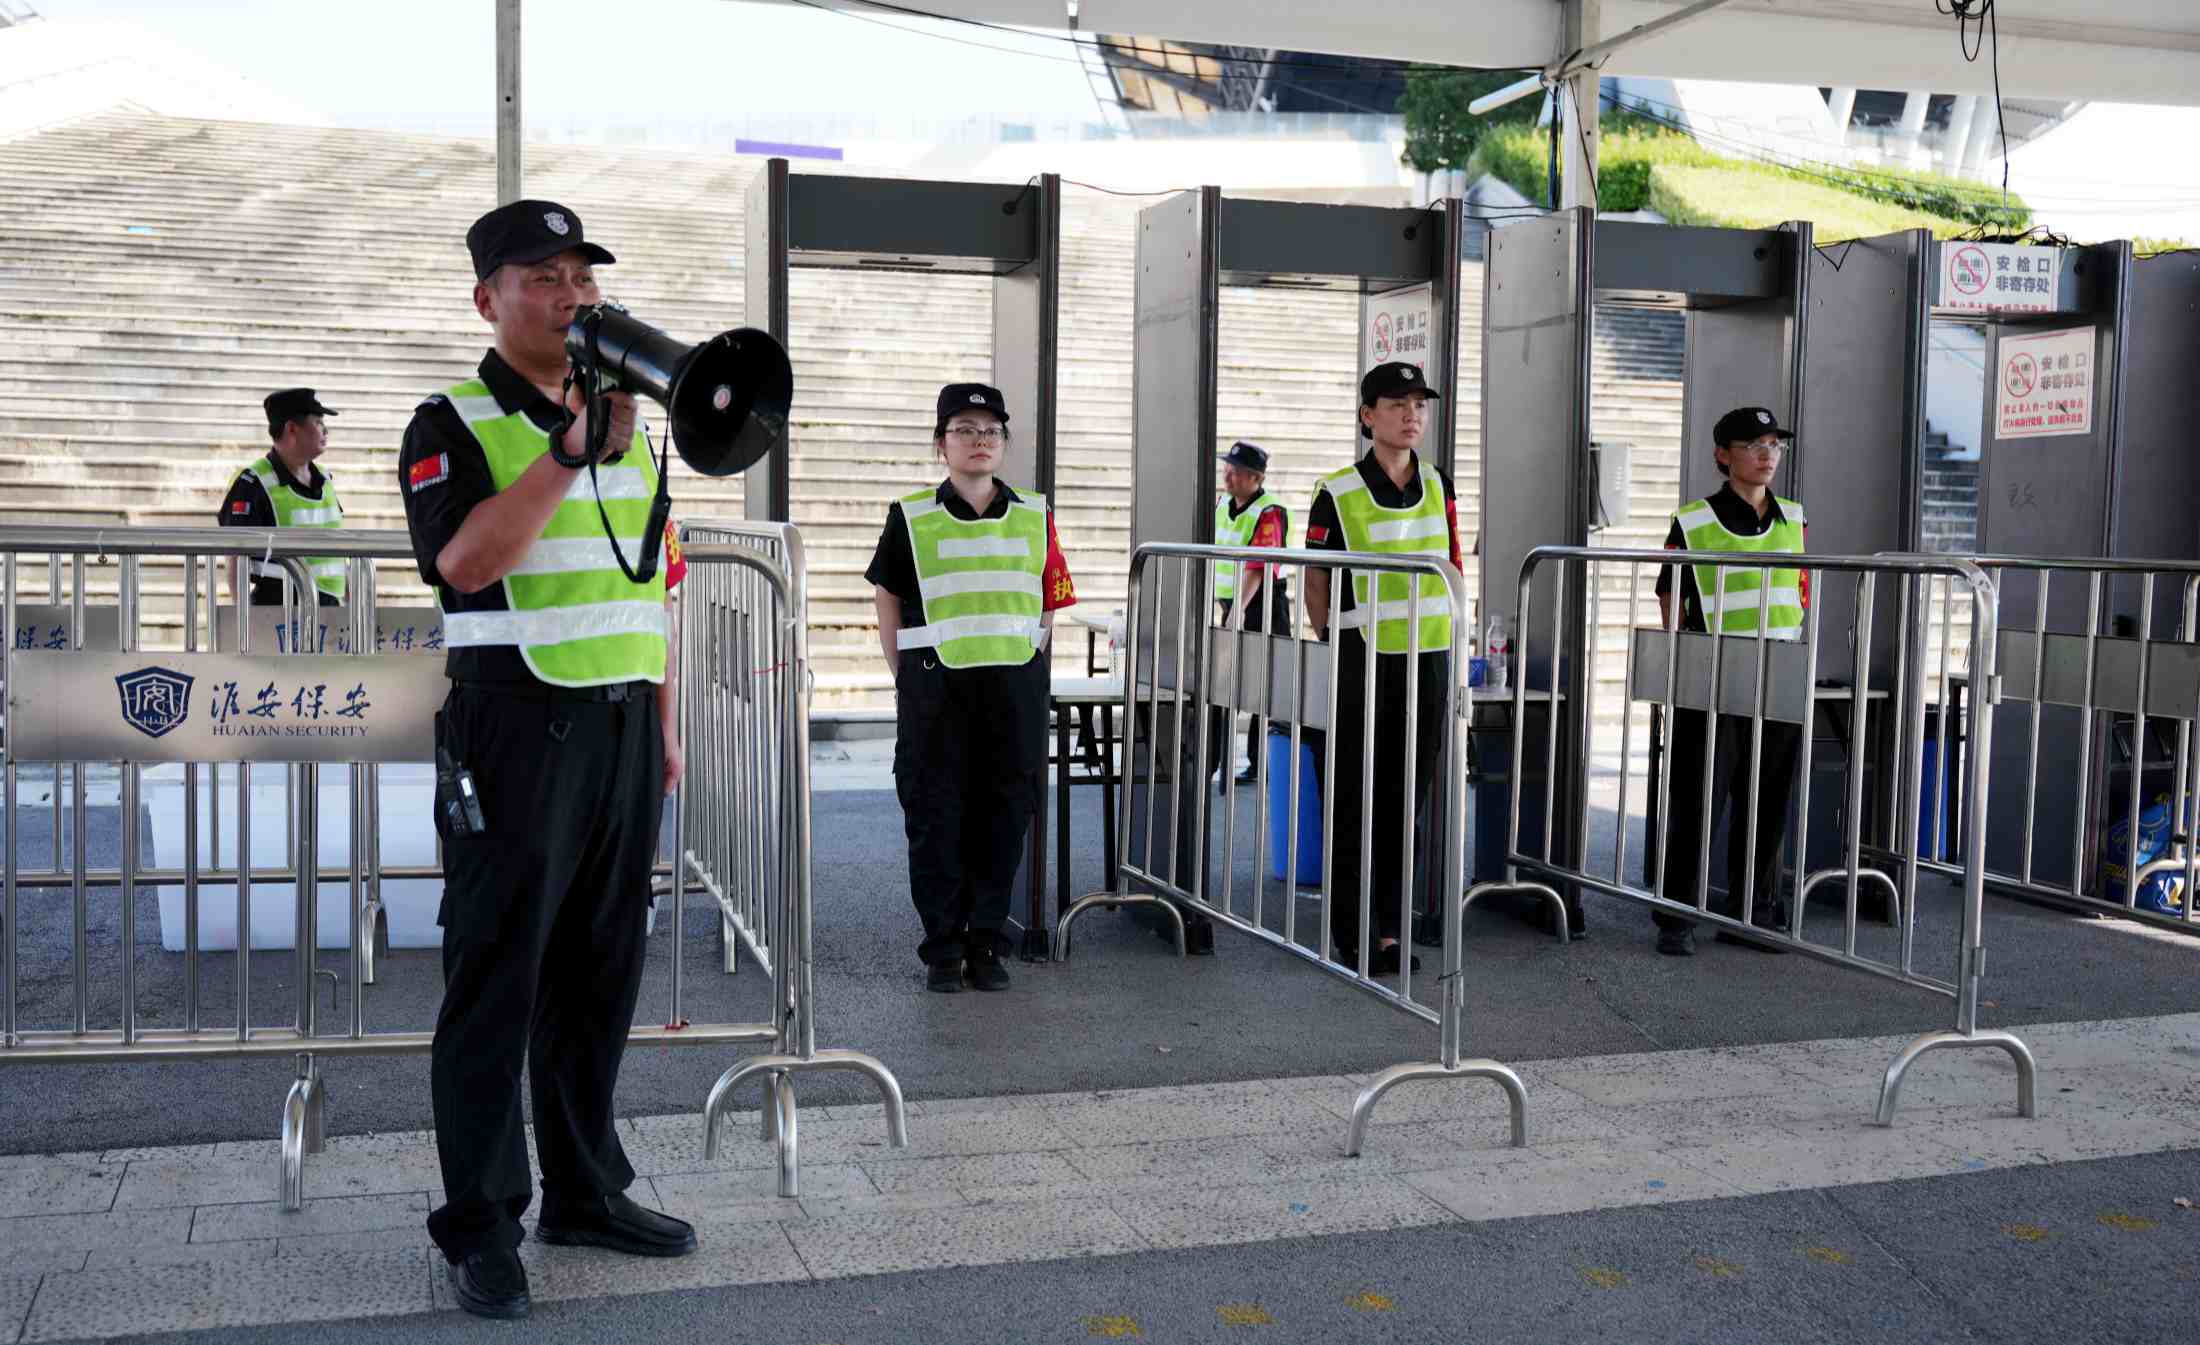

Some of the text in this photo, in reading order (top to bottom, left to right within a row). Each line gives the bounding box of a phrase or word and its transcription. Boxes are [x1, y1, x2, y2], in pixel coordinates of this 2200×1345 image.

[1996, 255, 2050, 273] 安检口
[1996, 275, 2050, 293] 非寄存处
[2041, 352, 2087, 370] 安检口
[210, 681, 371, 723] 淮安保安
[212, 724, 369, 737] HUAIAN SECURITY
